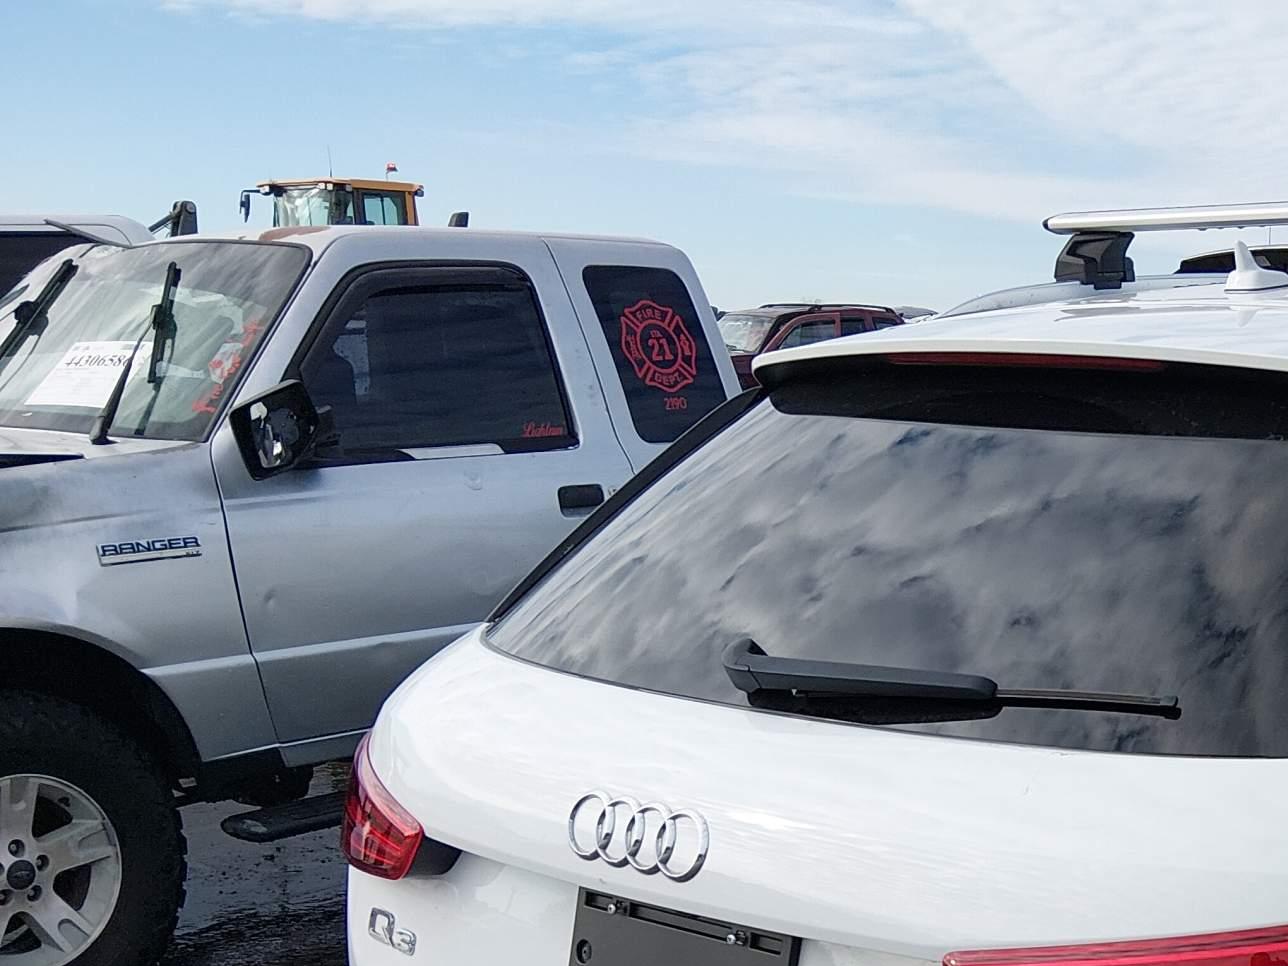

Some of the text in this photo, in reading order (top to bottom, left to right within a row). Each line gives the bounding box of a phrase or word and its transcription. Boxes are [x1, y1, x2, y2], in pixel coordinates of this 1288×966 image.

[636, 308, 663, 321] FIRE
[648, 338, 674, 361] 21
[100, 535, 201, 556] RANGER
[368, 906, 417, 956] Q3
